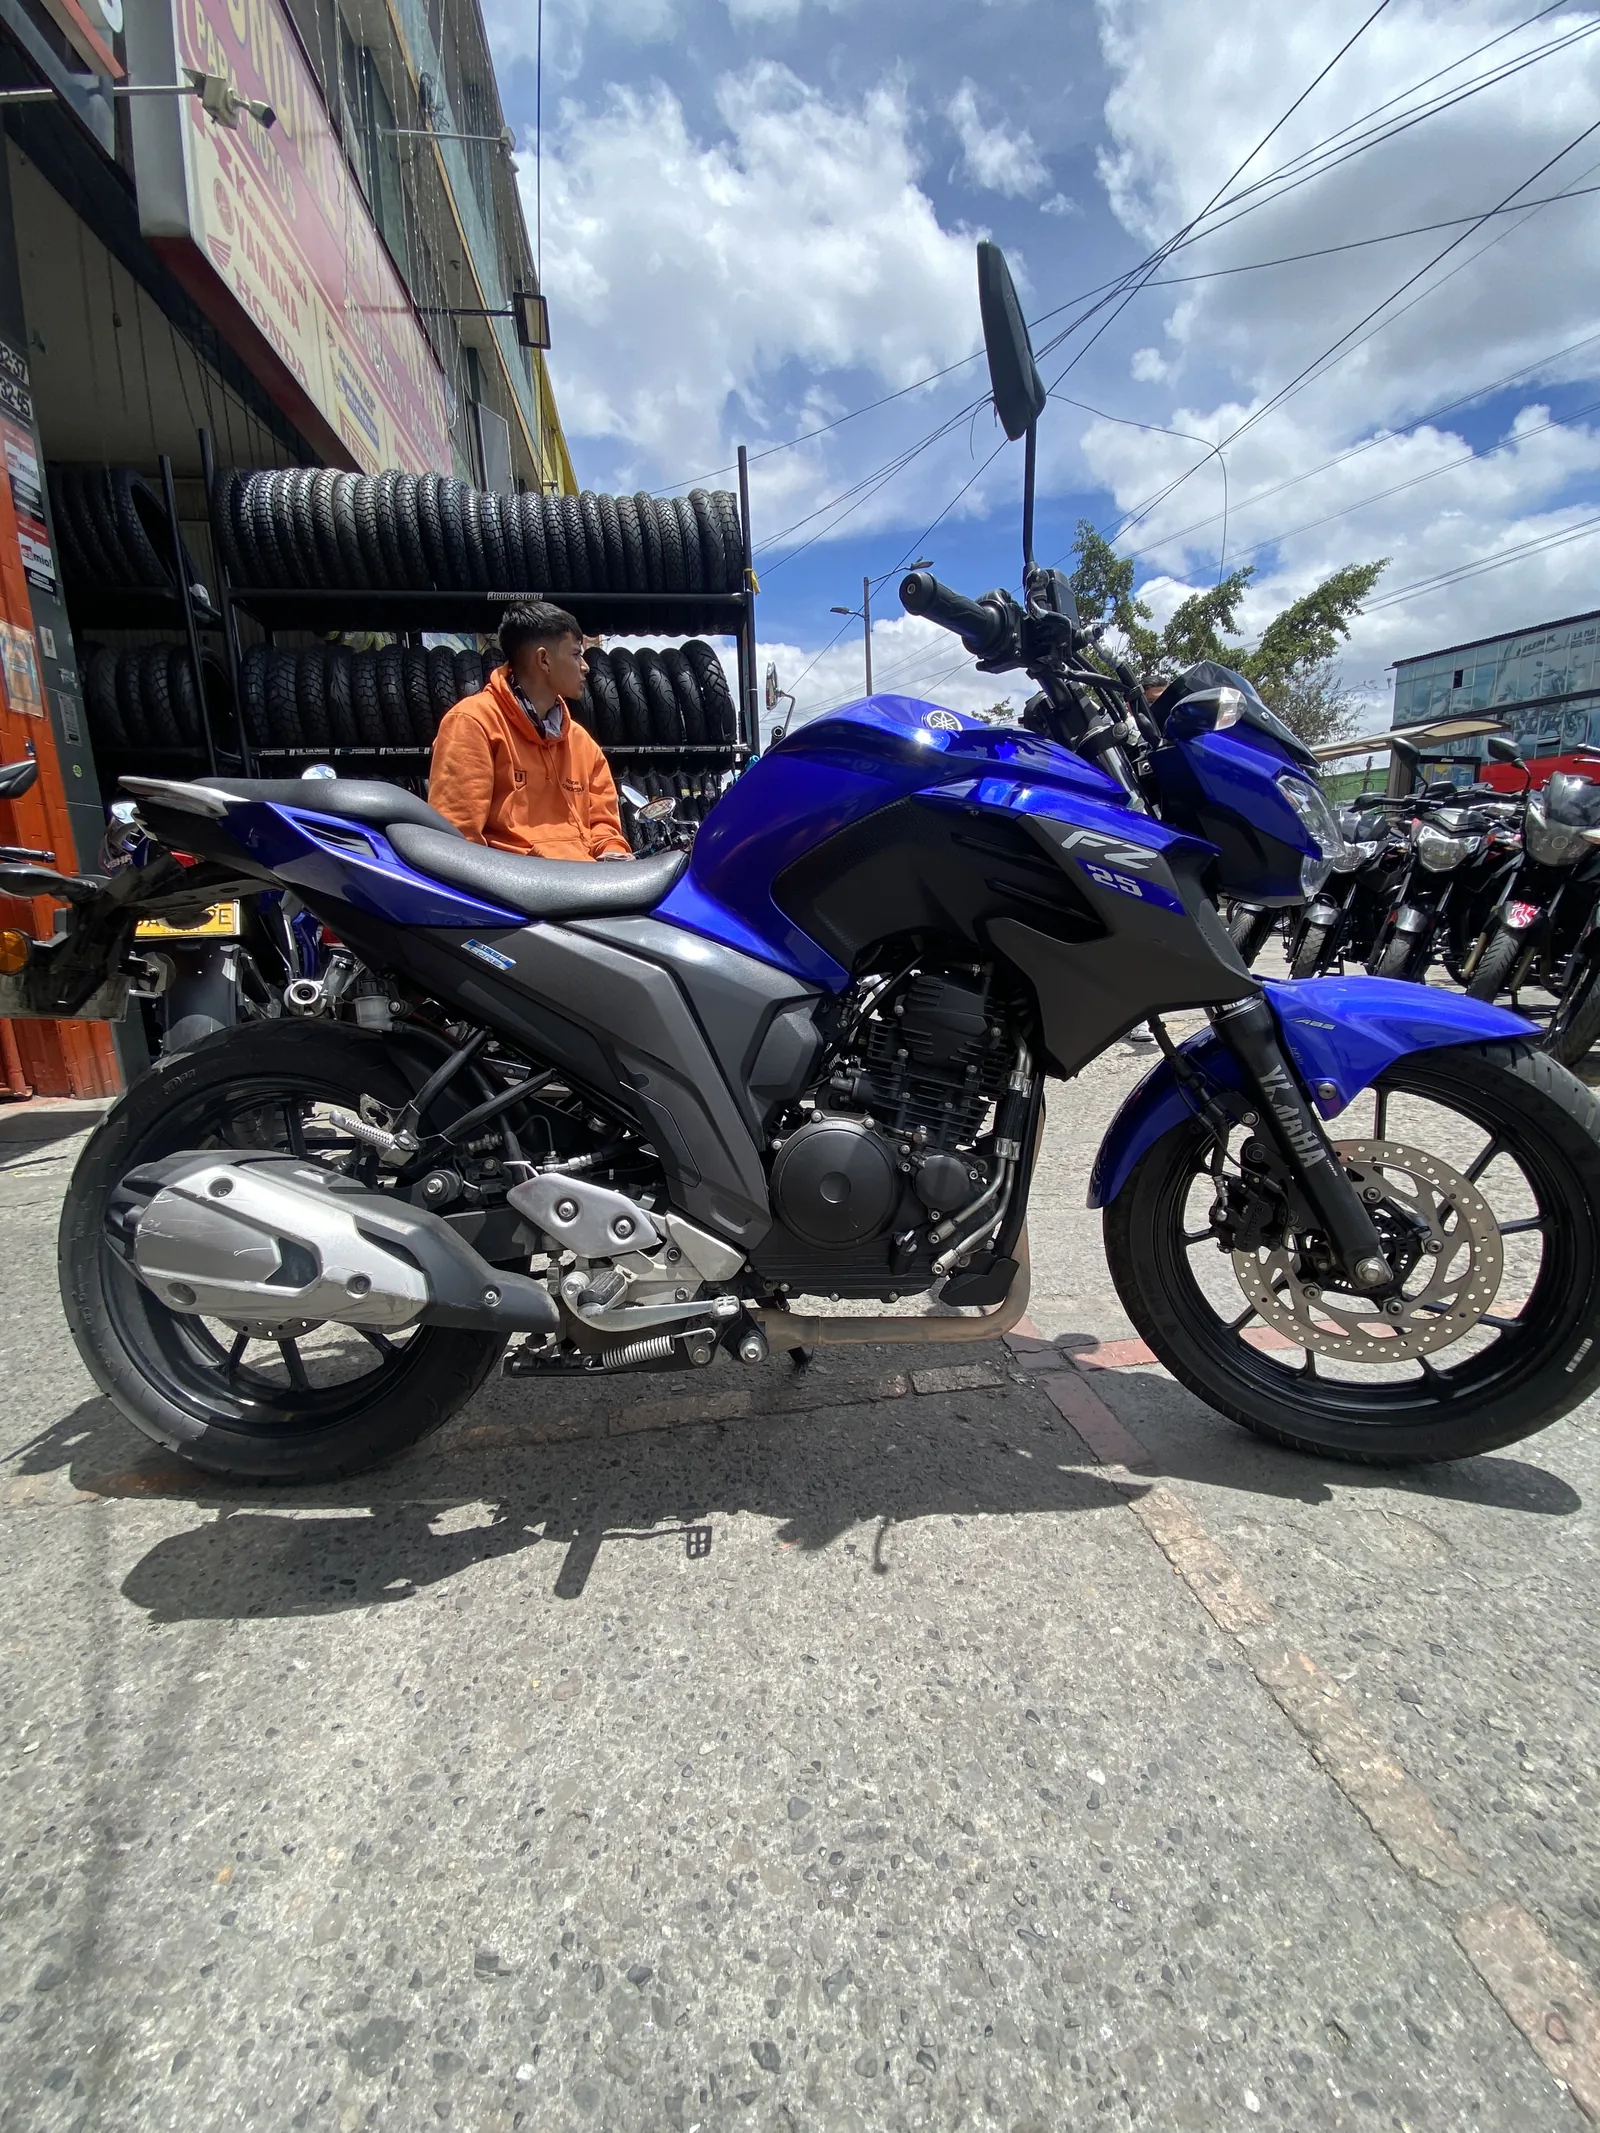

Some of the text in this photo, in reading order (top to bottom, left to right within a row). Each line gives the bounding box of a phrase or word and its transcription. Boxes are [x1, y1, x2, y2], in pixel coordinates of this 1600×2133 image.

[234, 206, 301, 338] YAMAHA
[235, 164, 308, 306] Kawasaki
[233, 266, 311, 391] HONDA
[344, 277, 403, 412] REPUESTOS
[338, 345, 376, 410] DUNLOP
[1061, 831, 1157, 869] FZ
[1086, 864, 1143, 897] 25
[1295, 1018, 1336, 1030] ABS
